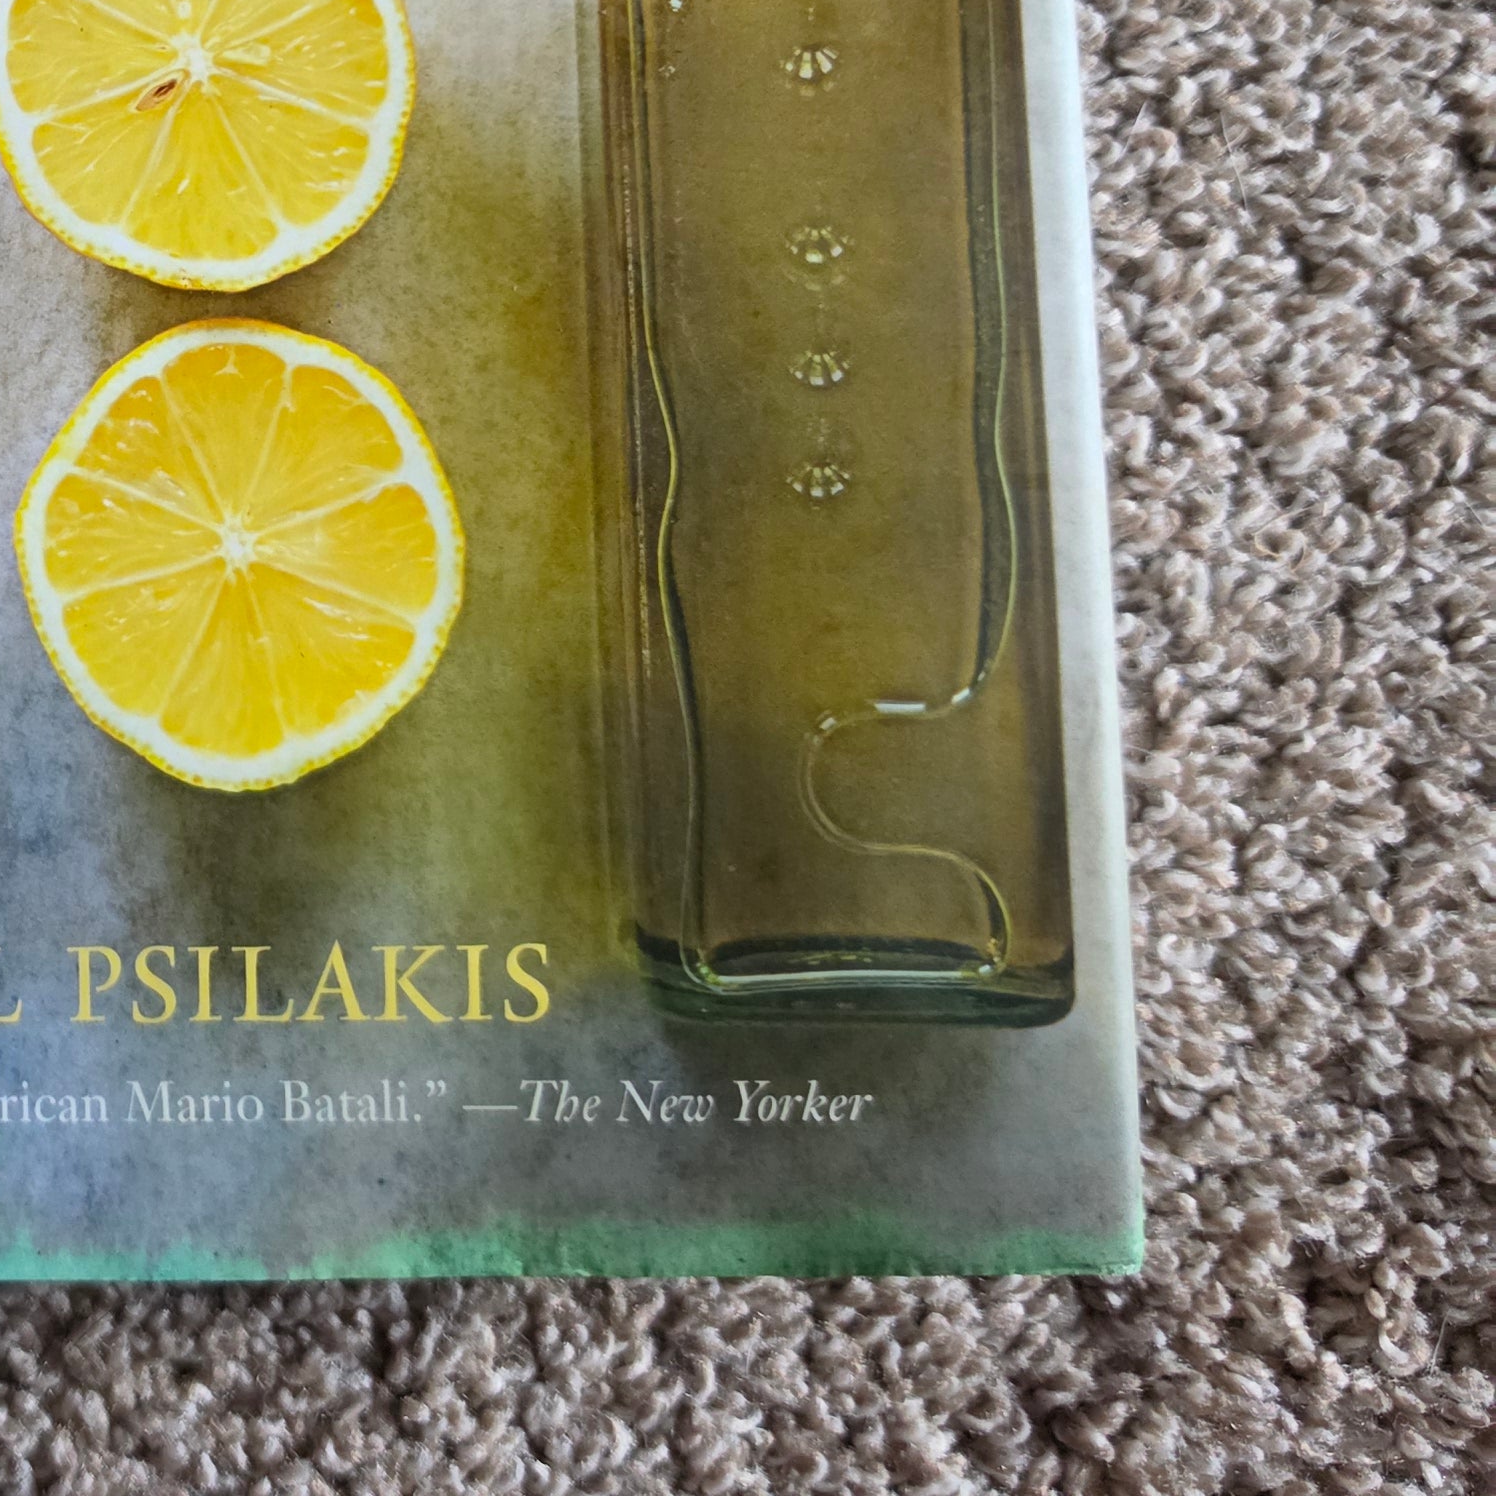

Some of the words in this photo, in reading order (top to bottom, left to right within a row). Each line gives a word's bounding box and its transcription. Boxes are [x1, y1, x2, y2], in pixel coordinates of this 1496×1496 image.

[66, 939, 552, 1025] PSILAKIS
[126, 1079, 266, 1124] Mario
[280, 1078, 448, 1124] Batali.”
[462, 1078, 601, 1125] —The
[615, 1078, 716, 1125] New
[732, 1077, 875, 1125] Yorker
